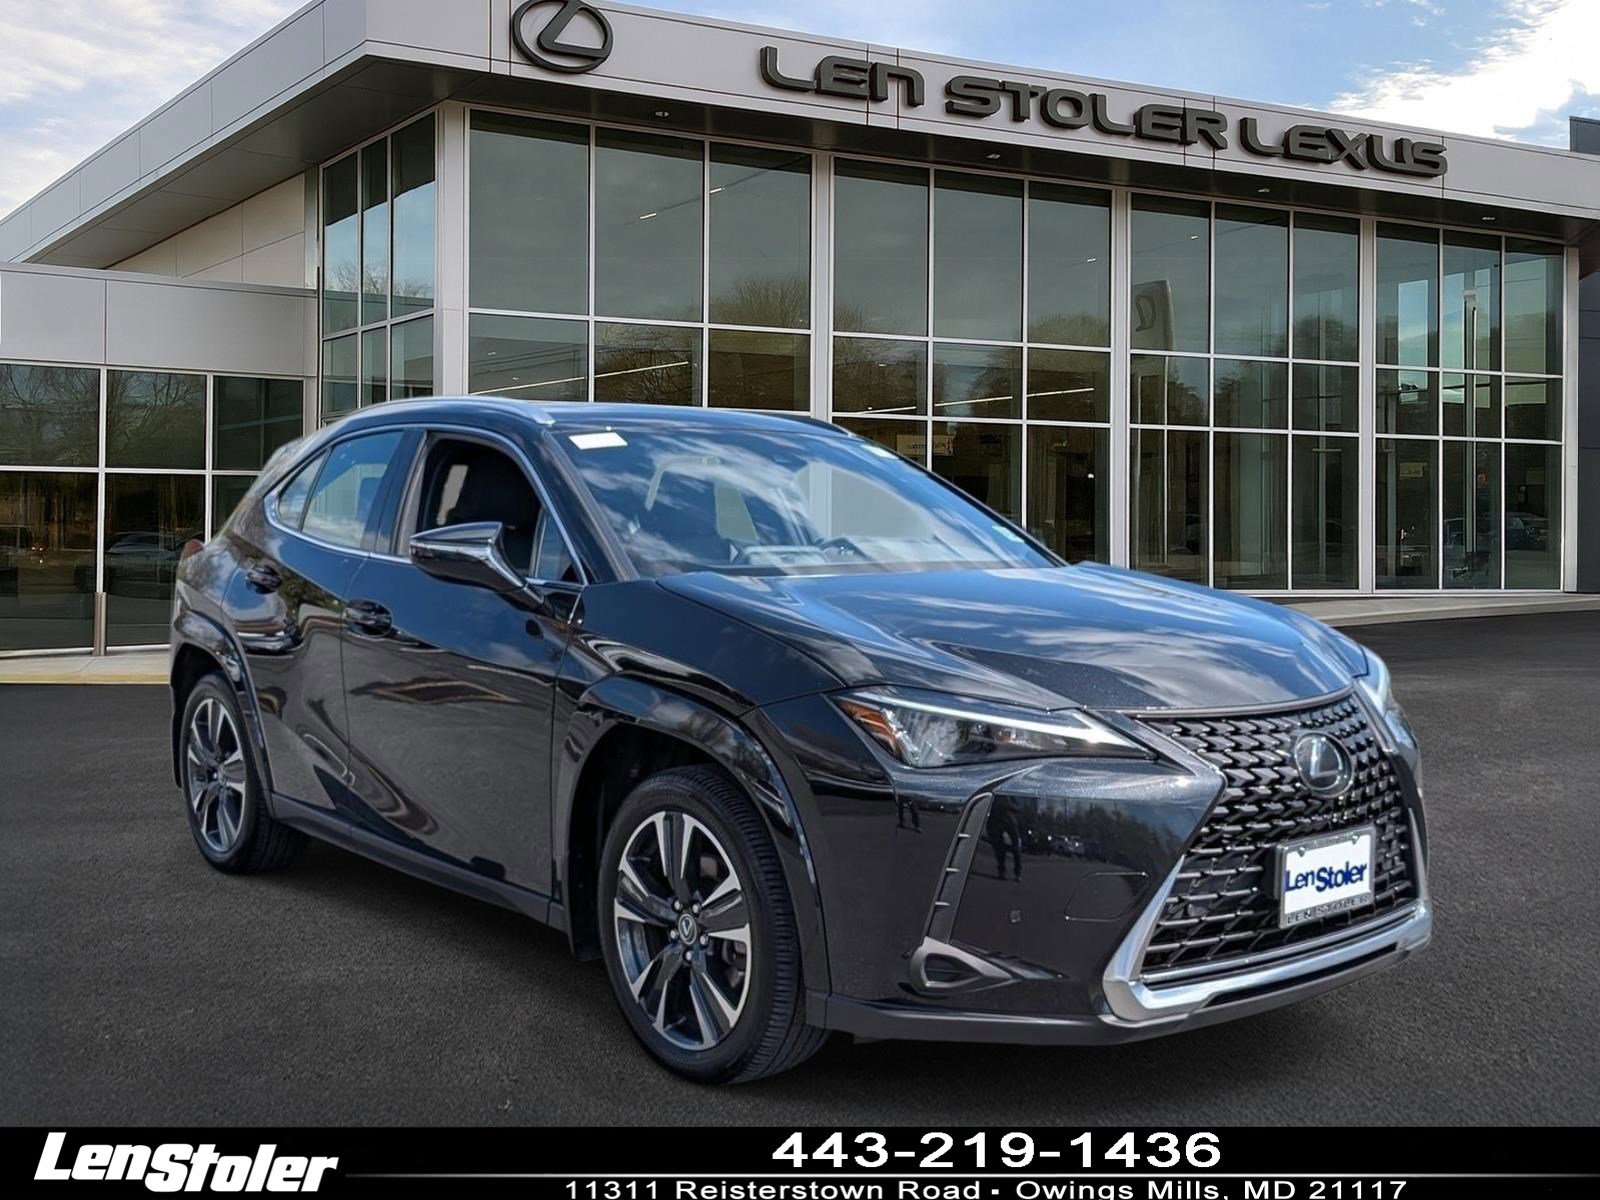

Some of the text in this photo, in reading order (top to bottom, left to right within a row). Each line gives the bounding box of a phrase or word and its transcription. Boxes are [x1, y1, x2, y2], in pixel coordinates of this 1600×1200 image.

[760, 45, 1448, 178] LEN STOLER LEXUS
